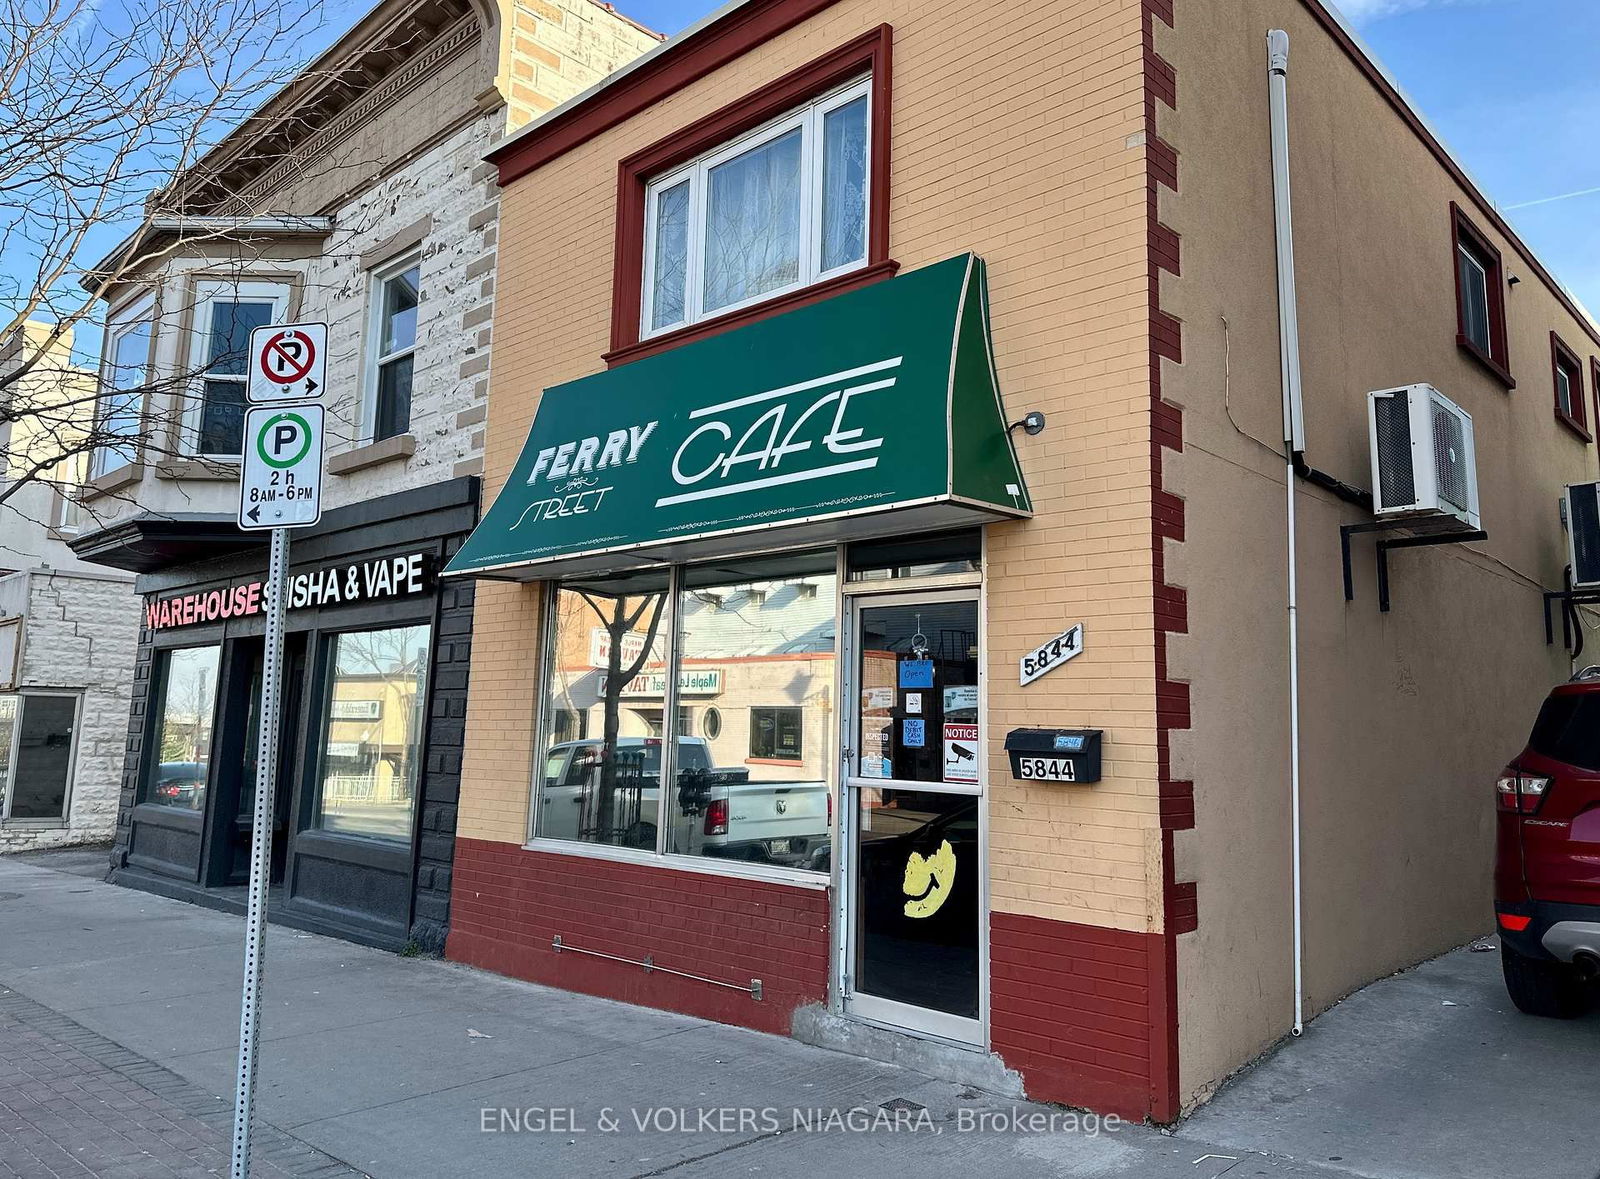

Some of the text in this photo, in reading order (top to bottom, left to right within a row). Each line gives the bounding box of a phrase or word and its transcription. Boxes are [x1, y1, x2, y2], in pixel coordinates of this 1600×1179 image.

[274, 425, 298, 455] P
[526, 420, 659, 486] FERRY
[671, 377, 897, 485] CAFE
[509, 486, 614, 532] STREET
[147, 582, 262, 630] WAREHOUSE
[344, 565, 360, 600] &
[364, 553, 423, 598] VAPE
[945, 729, 978, 739] NOTICE
[1021, 759, 1074, 780] 5844
